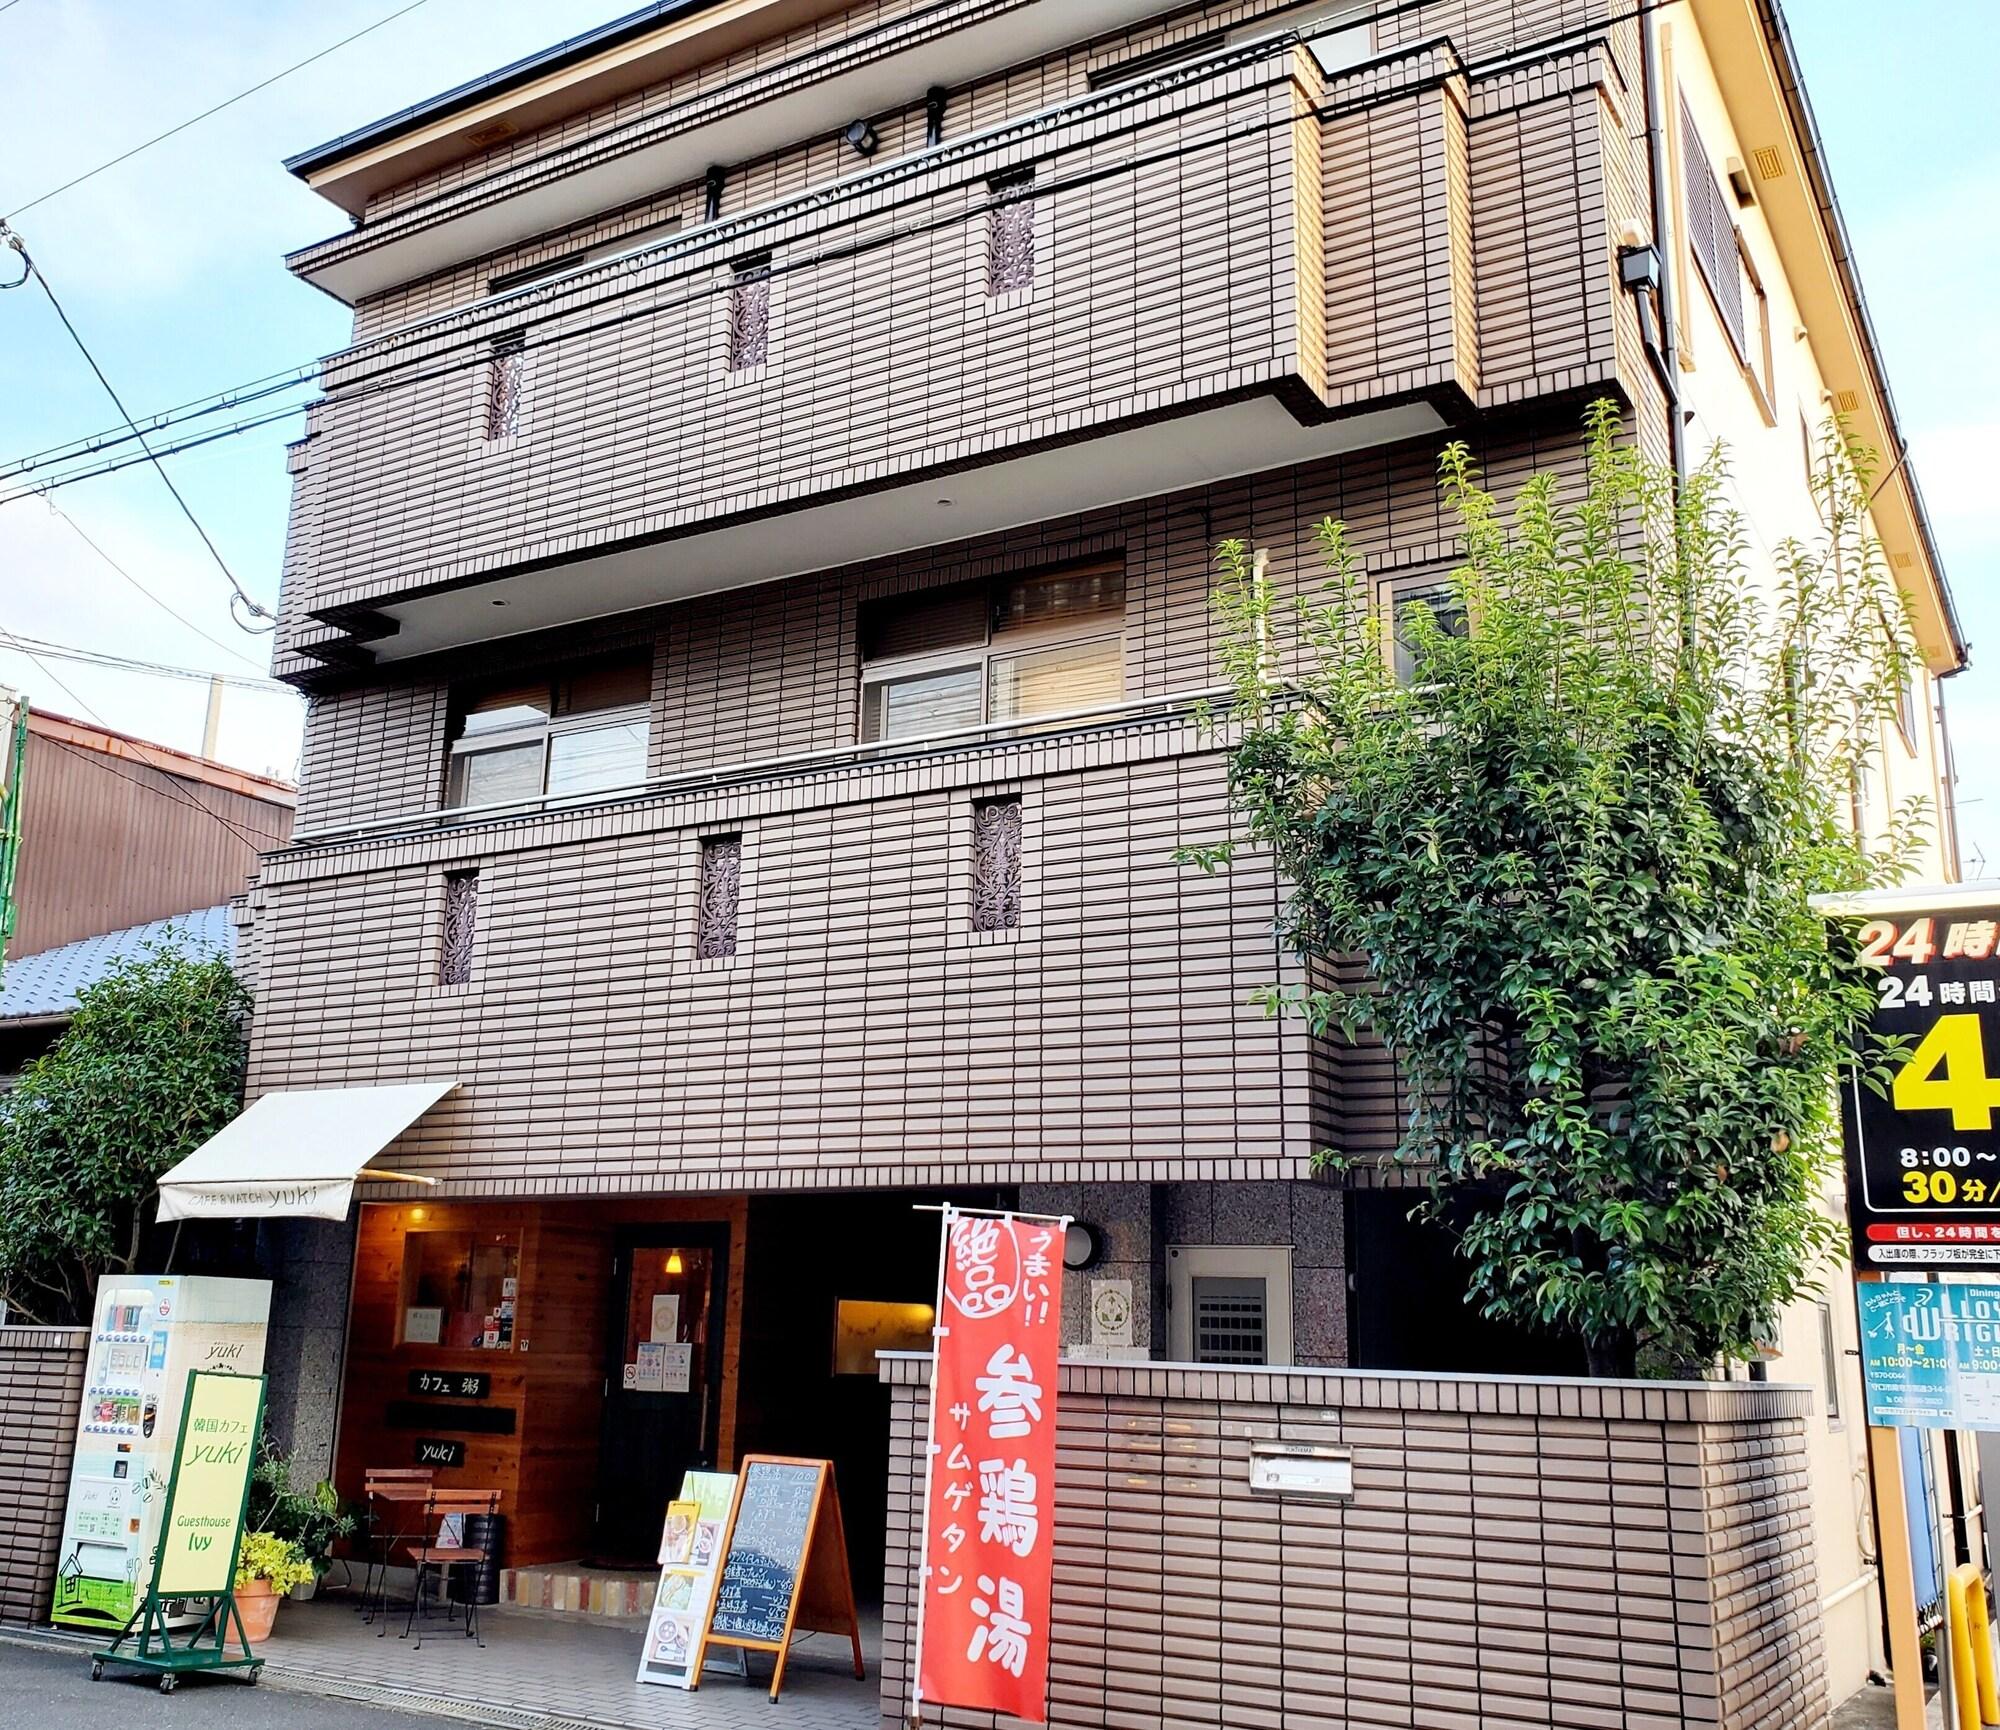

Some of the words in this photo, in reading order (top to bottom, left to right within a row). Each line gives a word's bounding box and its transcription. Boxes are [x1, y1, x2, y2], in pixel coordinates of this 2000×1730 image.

[1857, 917, 2000, 966] 24時
[268, 1185, 317, 1208] yuki
[950, 1217, 1011, 1314] 絶品
[204, 1344, 244, 1360] yuki
[419, 1373, 450, 1393] カフェ
[461, 1378, 480, 1394] 粥
[193, 1418, 248, 1434] 韓国カフェ
[185, 1441, 248, 1467] yuki
[421, 1444, 455, 1462] yuki
[937, 1401, 973, 1596] サムゲタン
[177, 1514, 232, 1528] Guesthouse
[966, 1342, 1043, 1679] 参鶏湯
[188, 1532, 213, 1551] Ivy
